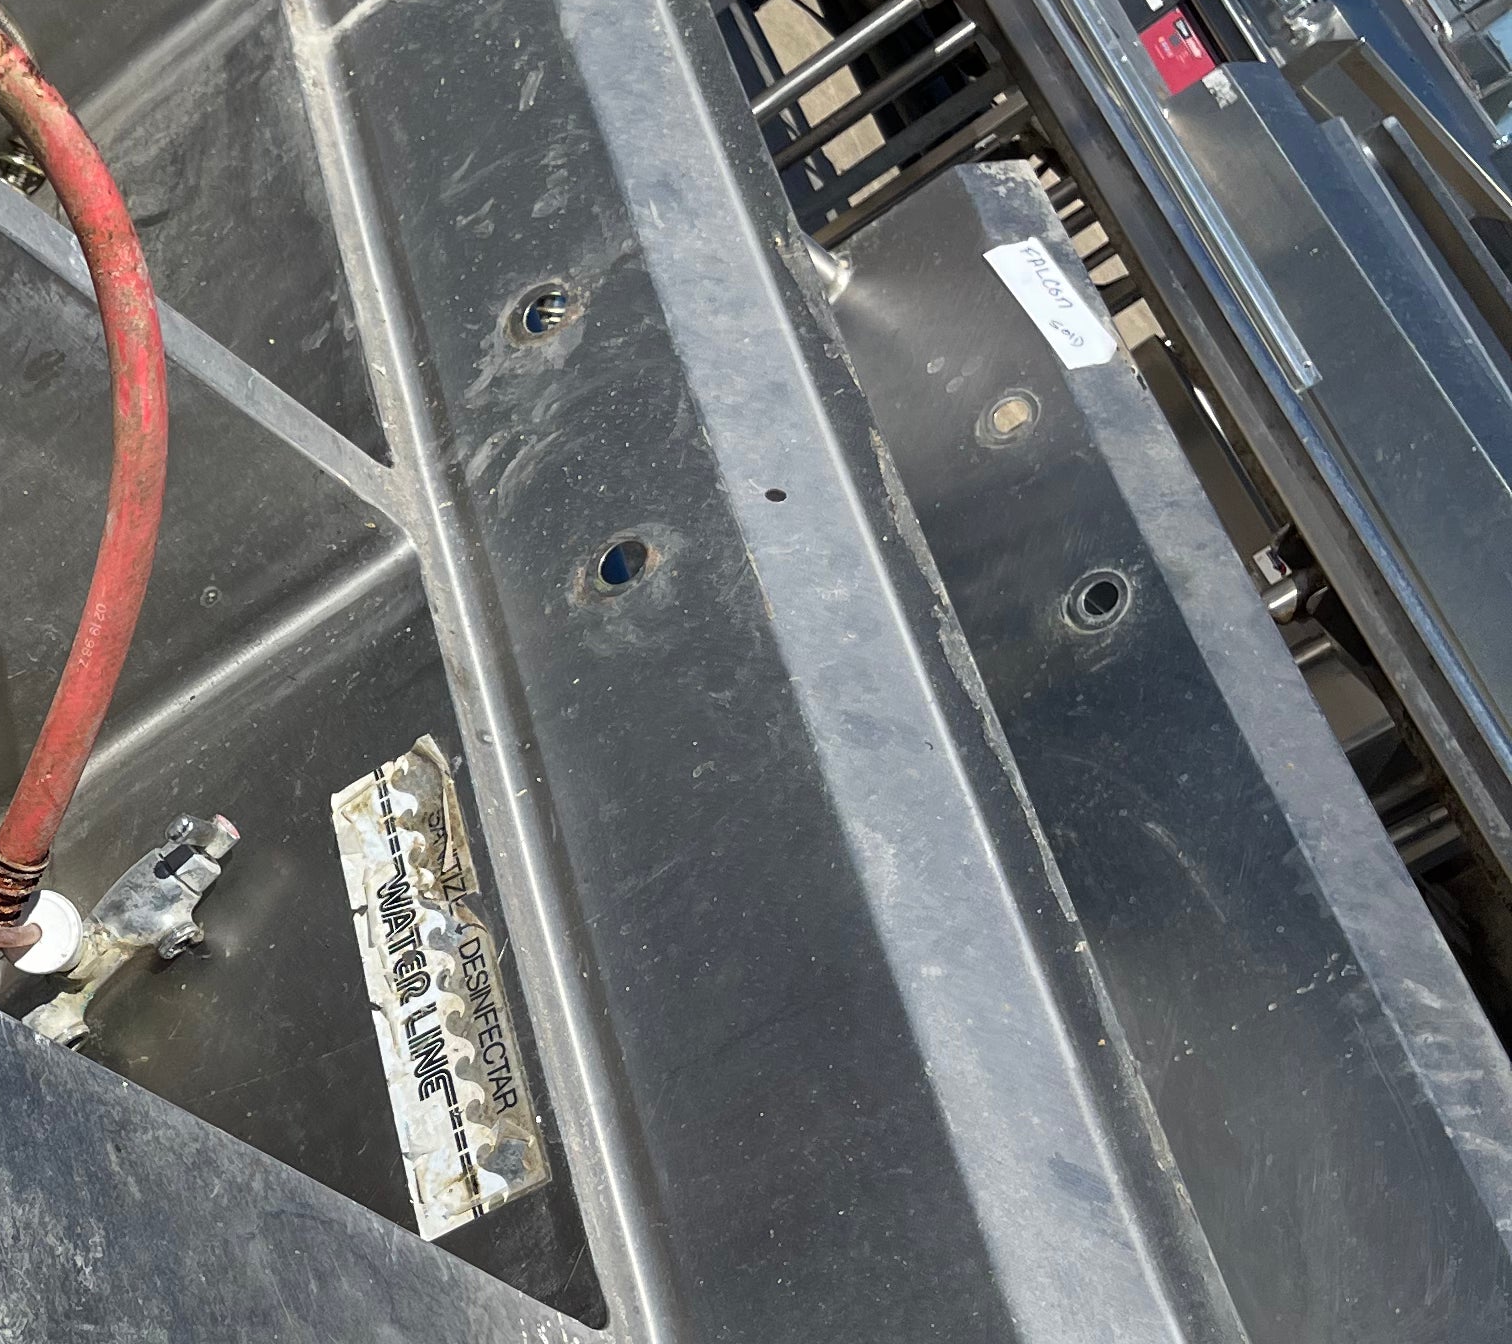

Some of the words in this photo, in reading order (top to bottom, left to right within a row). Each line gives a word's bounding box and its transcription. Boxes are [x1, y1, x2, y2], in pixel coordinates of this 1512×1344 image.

[377, 864, 431, 1006] WATER
[402, 1001, 456, 1102] LINE
[458, 935, 518, 1115] DESINFECTAR
